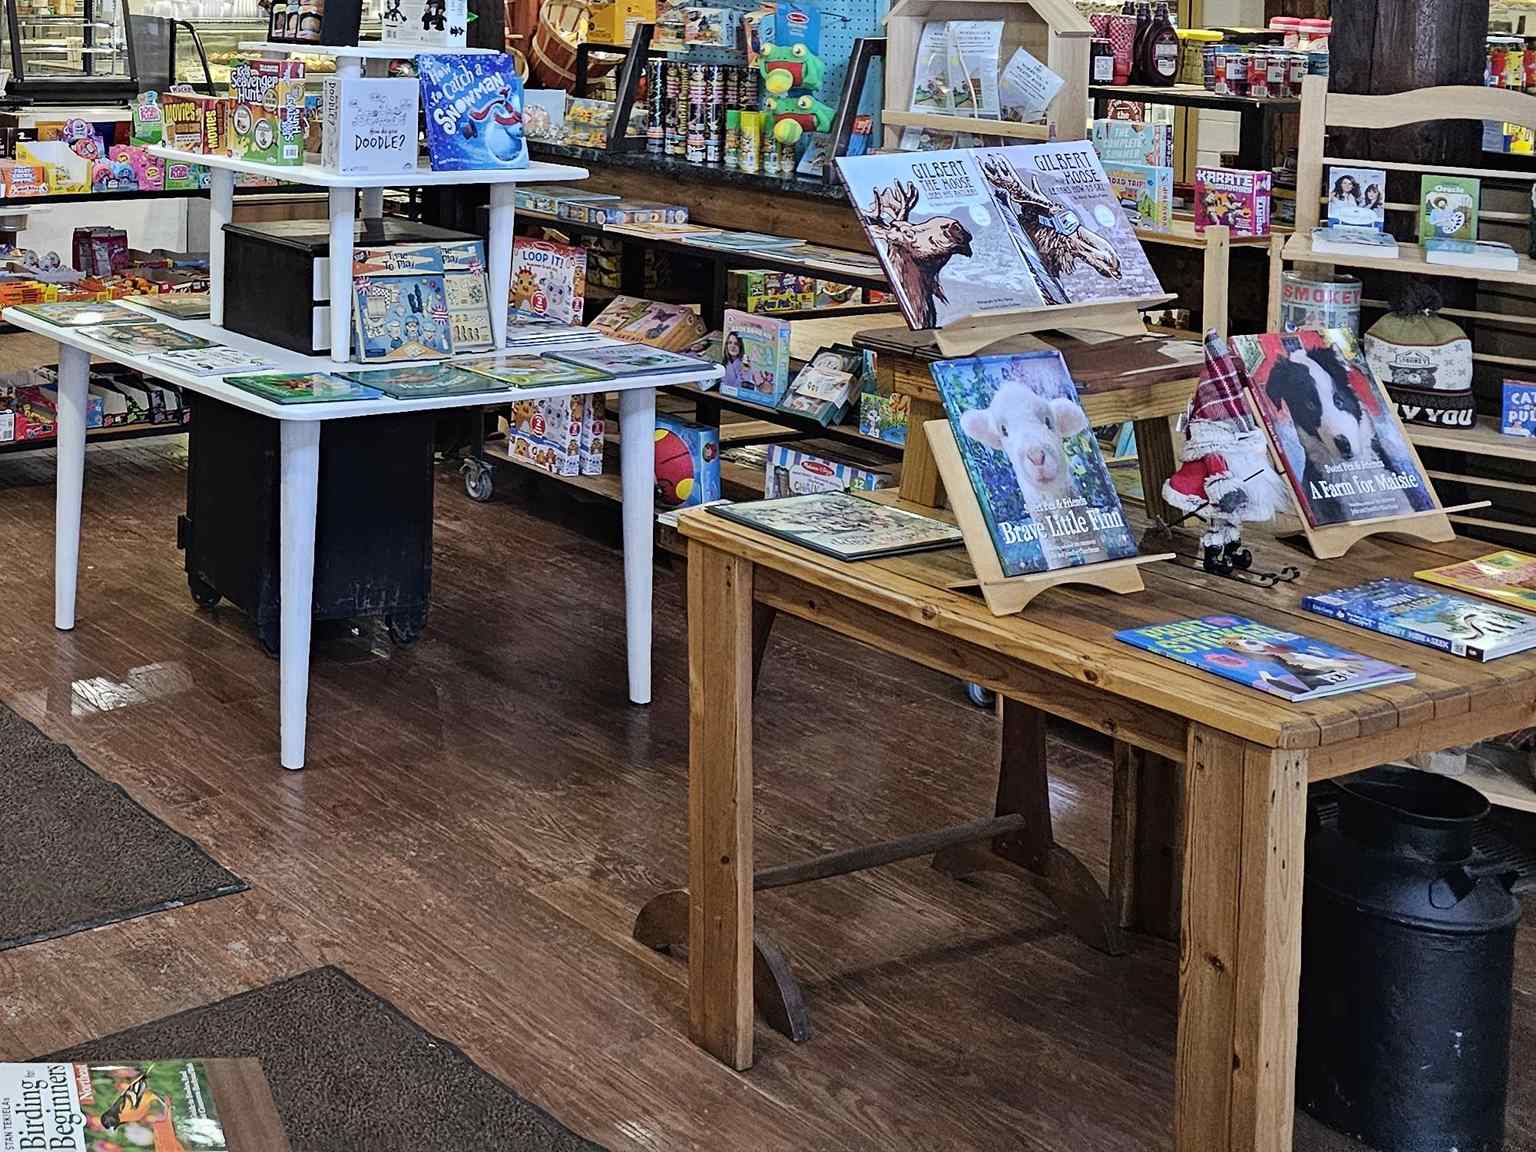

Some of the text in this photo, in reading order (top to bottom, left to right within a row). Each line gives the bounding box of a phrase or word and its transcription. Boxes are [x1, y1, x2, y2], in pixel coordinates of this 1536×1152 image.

[230, 70, 279, 93] Scavenger
[428, 63, 451, 86] How
[237, 86, 264, 104] Hunt
[354, 134, 406, 152] DOODLE?
[911, 159, 969, 180] GILBERT
[1033, 151, 1093, 172] GILBERT
[918, 176, 975, 192] THE MOOSE
[1064, 169, 1101, 185] MOOSE
[1196, 169, 1254, 187] KARATE
[522, 250, 565, 269] LOOP IT!
[1282, 283, 1361, 305] SMOKEY
[1424, 407, 1474, 426] YOU
[1309, 471, 1419, 500] A Farm for Maisie
[998, 506, 1125, 545] Brave Little Finn
[16, 1078, 48, 1152] Birding
[47, 1064, 82, 1152] Beginners
[4, 1129, 14, 1150] STAN
